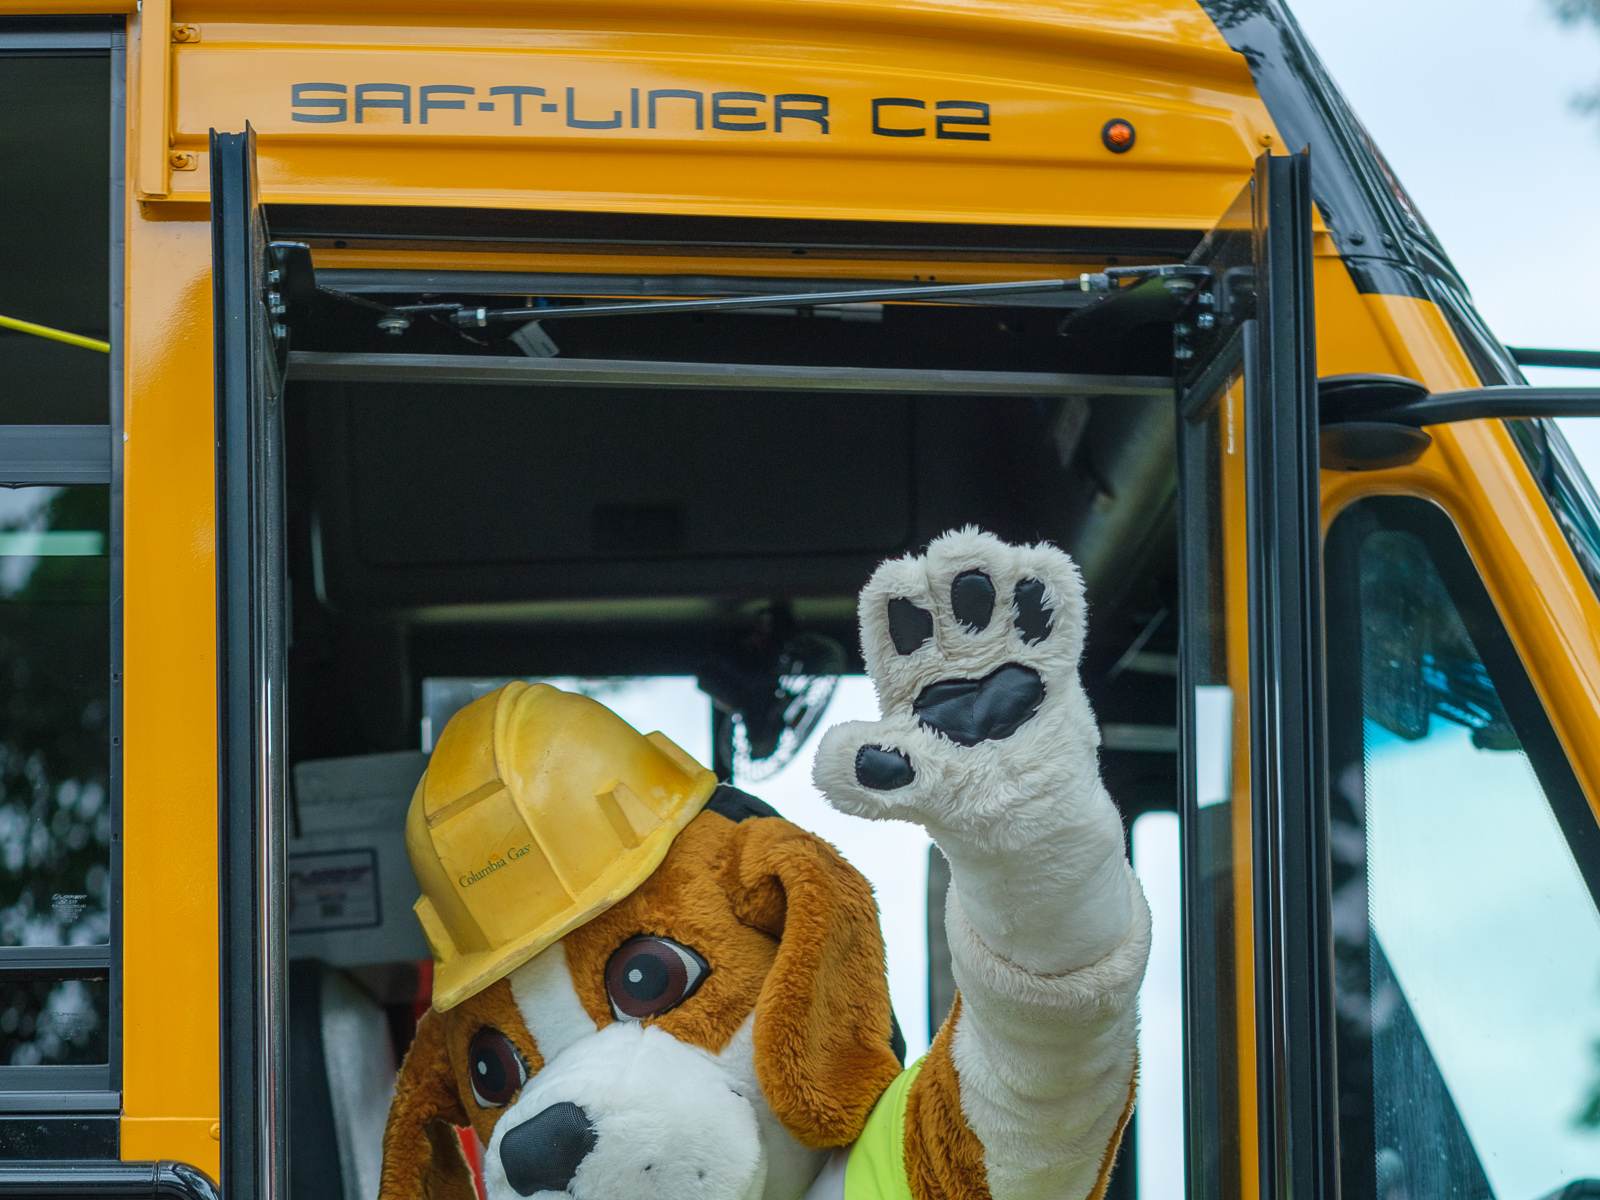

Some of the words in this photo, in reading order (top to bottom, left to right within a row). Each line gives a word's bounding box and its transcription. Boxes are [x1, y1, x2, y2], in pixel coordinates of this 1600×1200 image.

[871, 97, 991, 142] C2
[458, 858, 507, 888] Columbia
[507, 843, 530, 861] Gas
